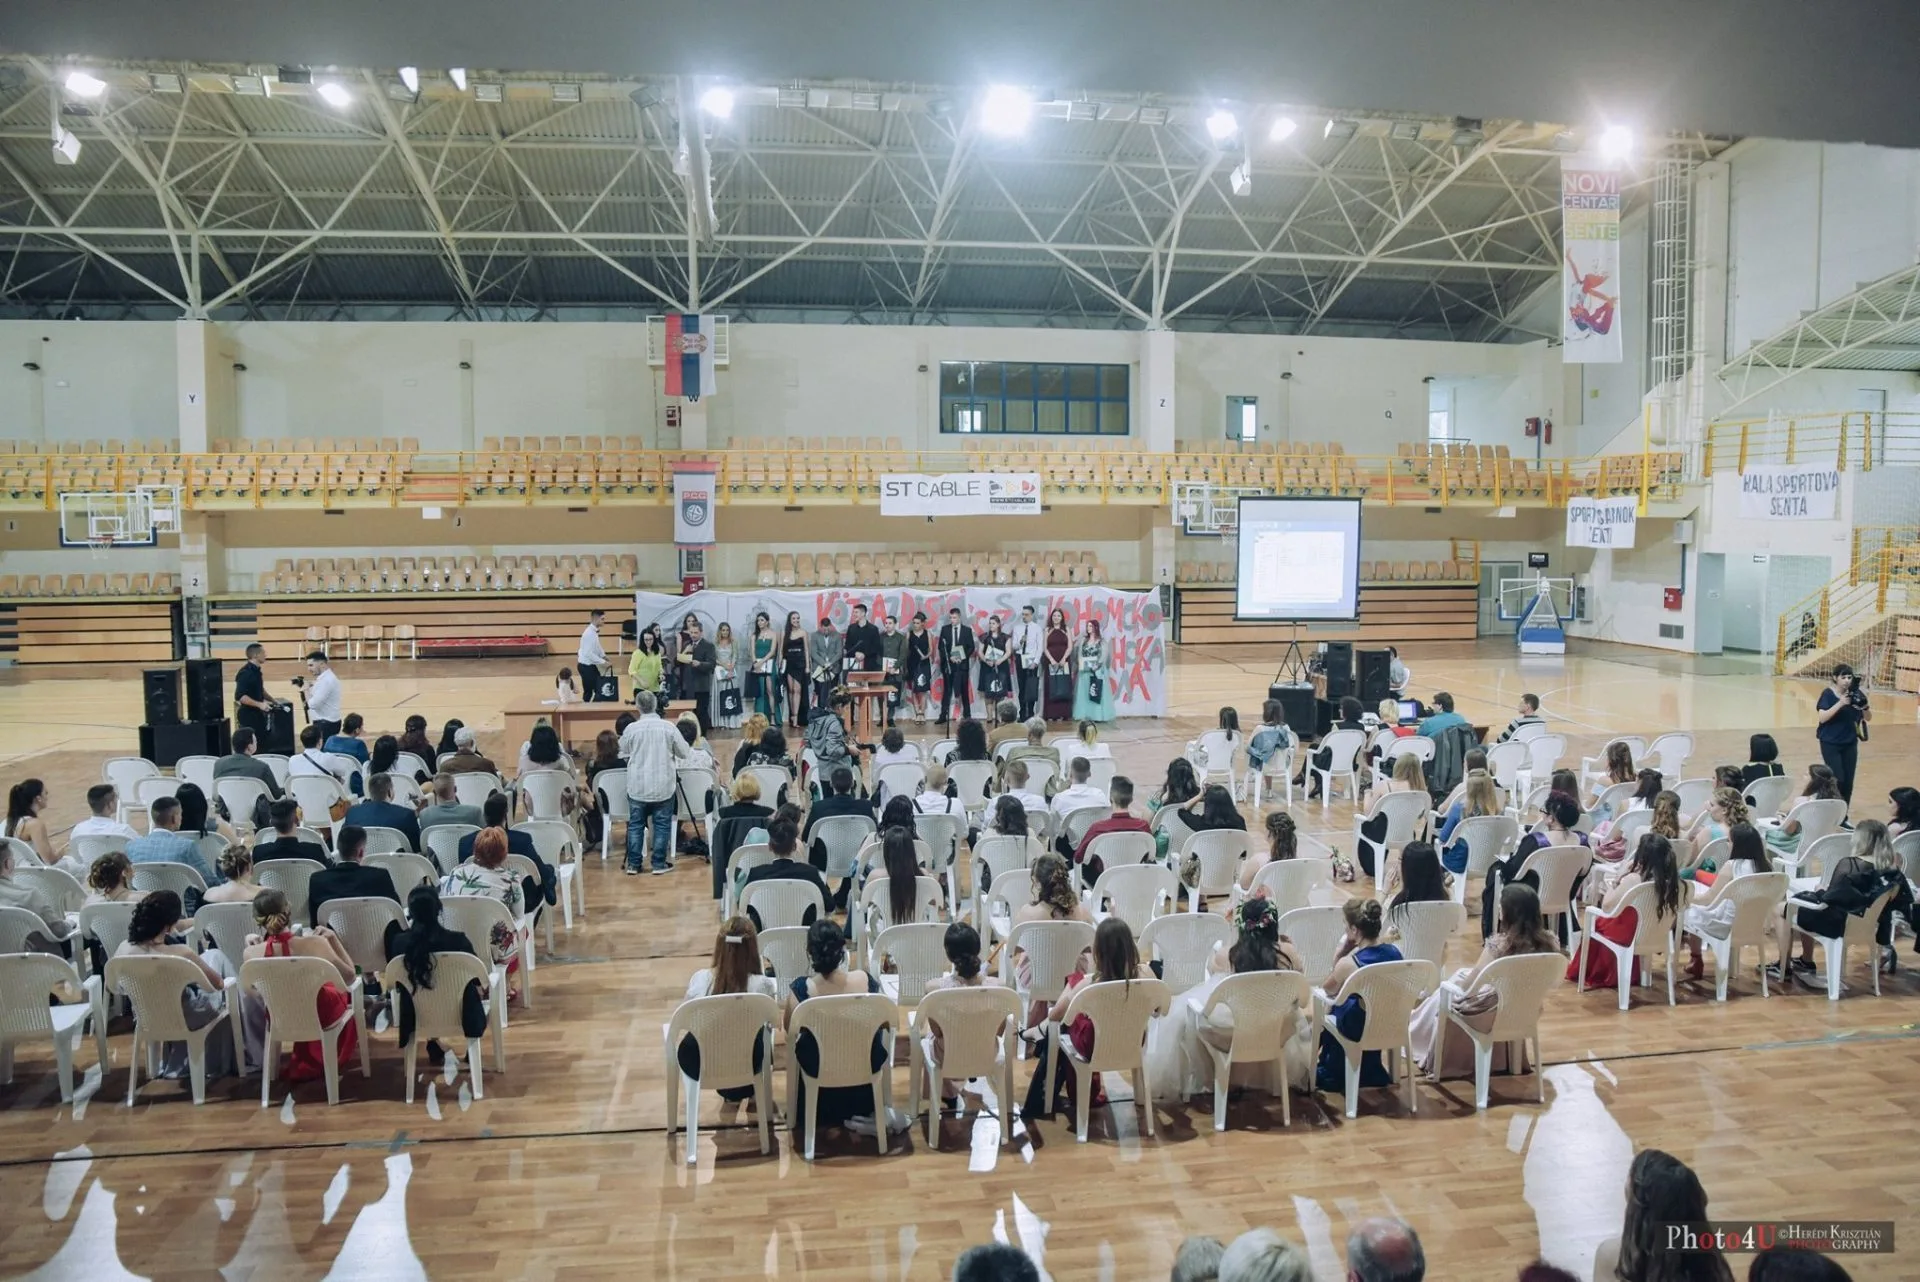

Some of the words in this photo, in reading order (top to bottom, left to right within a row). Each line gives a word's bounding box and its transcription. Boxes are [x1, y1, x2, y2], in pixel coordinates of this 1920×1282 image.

[1563, 173, 1616, 193] NOVI
[1563, 196, 1618, 209] CENTAR
[1564, 224, 1618, 239] SENTE
[188, 394, 196, 404] Y
[1159, 399, 1166, 408] Z
[1385, 410, 1392, 419] Q
[1743, 474, 1773, 494] HALA
[1776, 470, 1839, 494] SPORTOVA
[886, 481, 912, 497] ST
[917, 480, 981, 498] CABLE
[1770, 496, 1808, 516] SENTA
[456, 517, 461, 526] J
[1162, 568, 1167, 576] 1
[192, 578, 198, 586] 2
